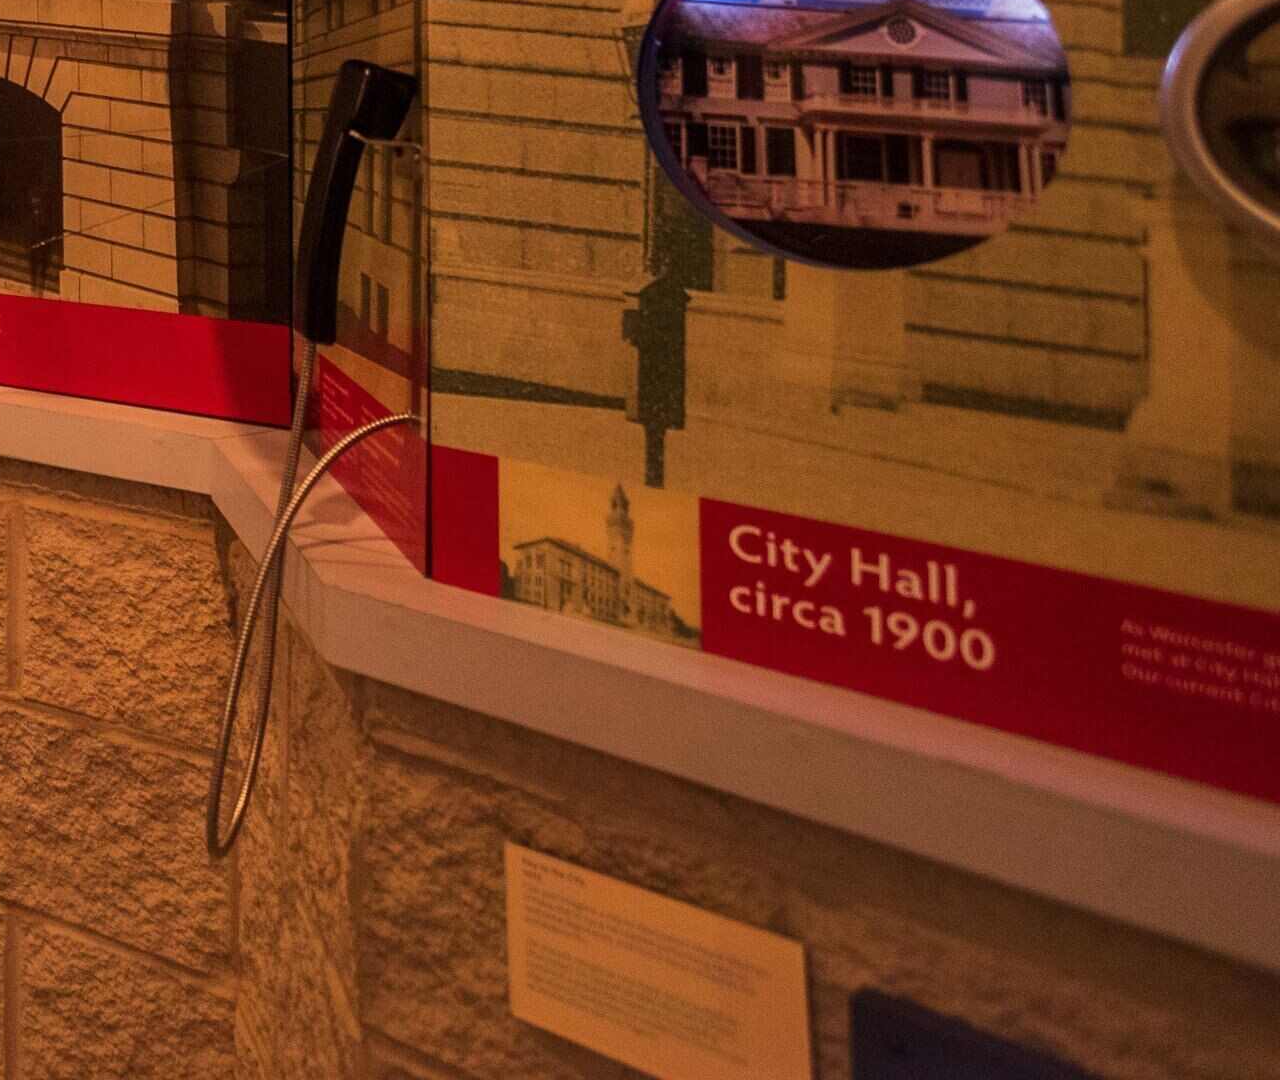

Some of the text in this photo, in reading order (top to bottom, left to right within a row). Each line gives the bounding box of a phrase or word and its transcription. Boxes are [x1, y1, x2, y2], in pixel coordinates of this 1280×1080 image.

[728, 523, 977, 619] City Hall,
[728, 579, 996, 671] circa 1900
